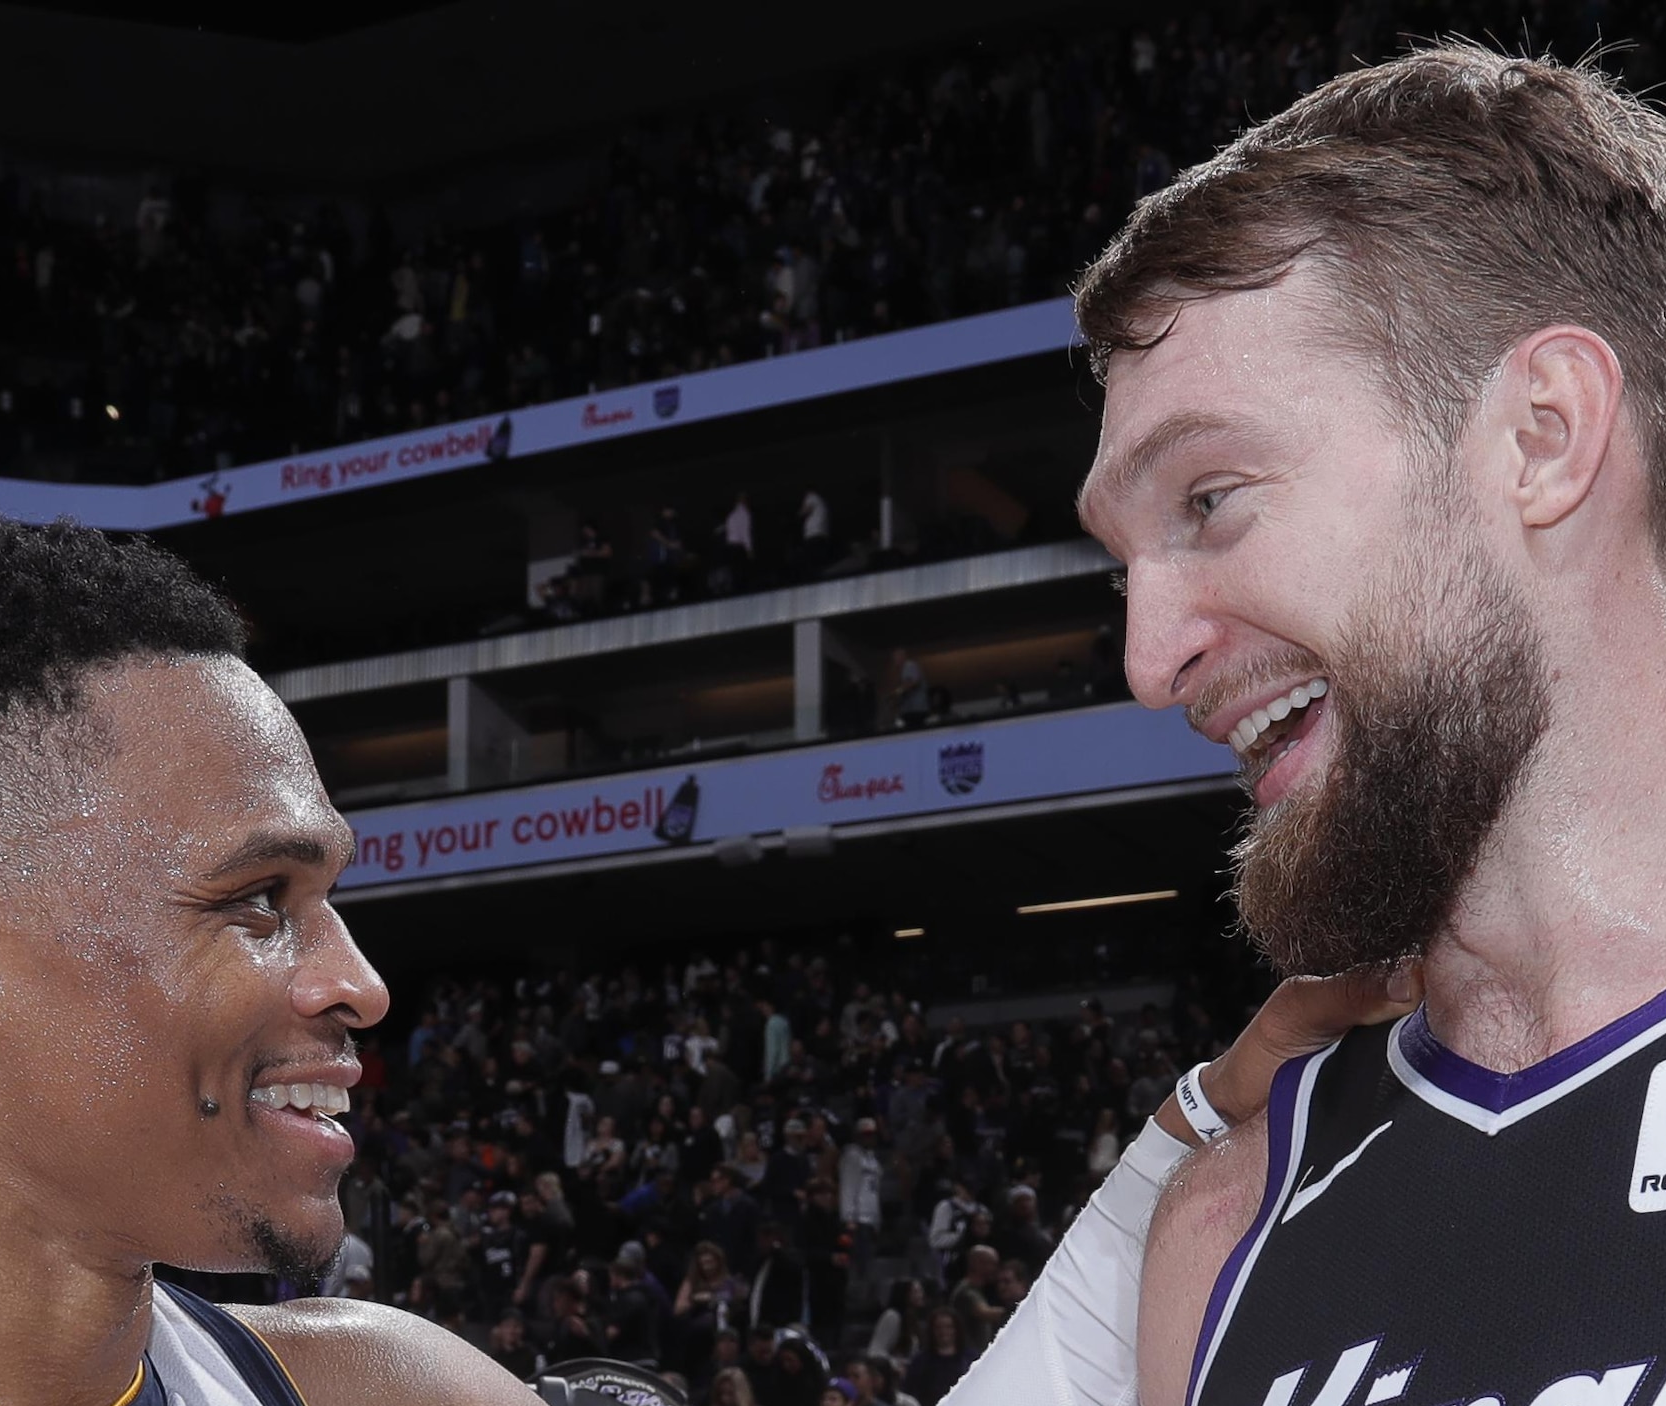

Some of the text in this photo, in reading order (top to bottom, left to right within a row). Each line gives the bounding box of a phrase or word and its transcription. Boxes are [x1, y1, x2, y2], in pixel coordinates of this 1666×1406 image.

[281, 424, 493, 490] Ring your cowbell
[352, 787, 667, 873] ing your cowbell
